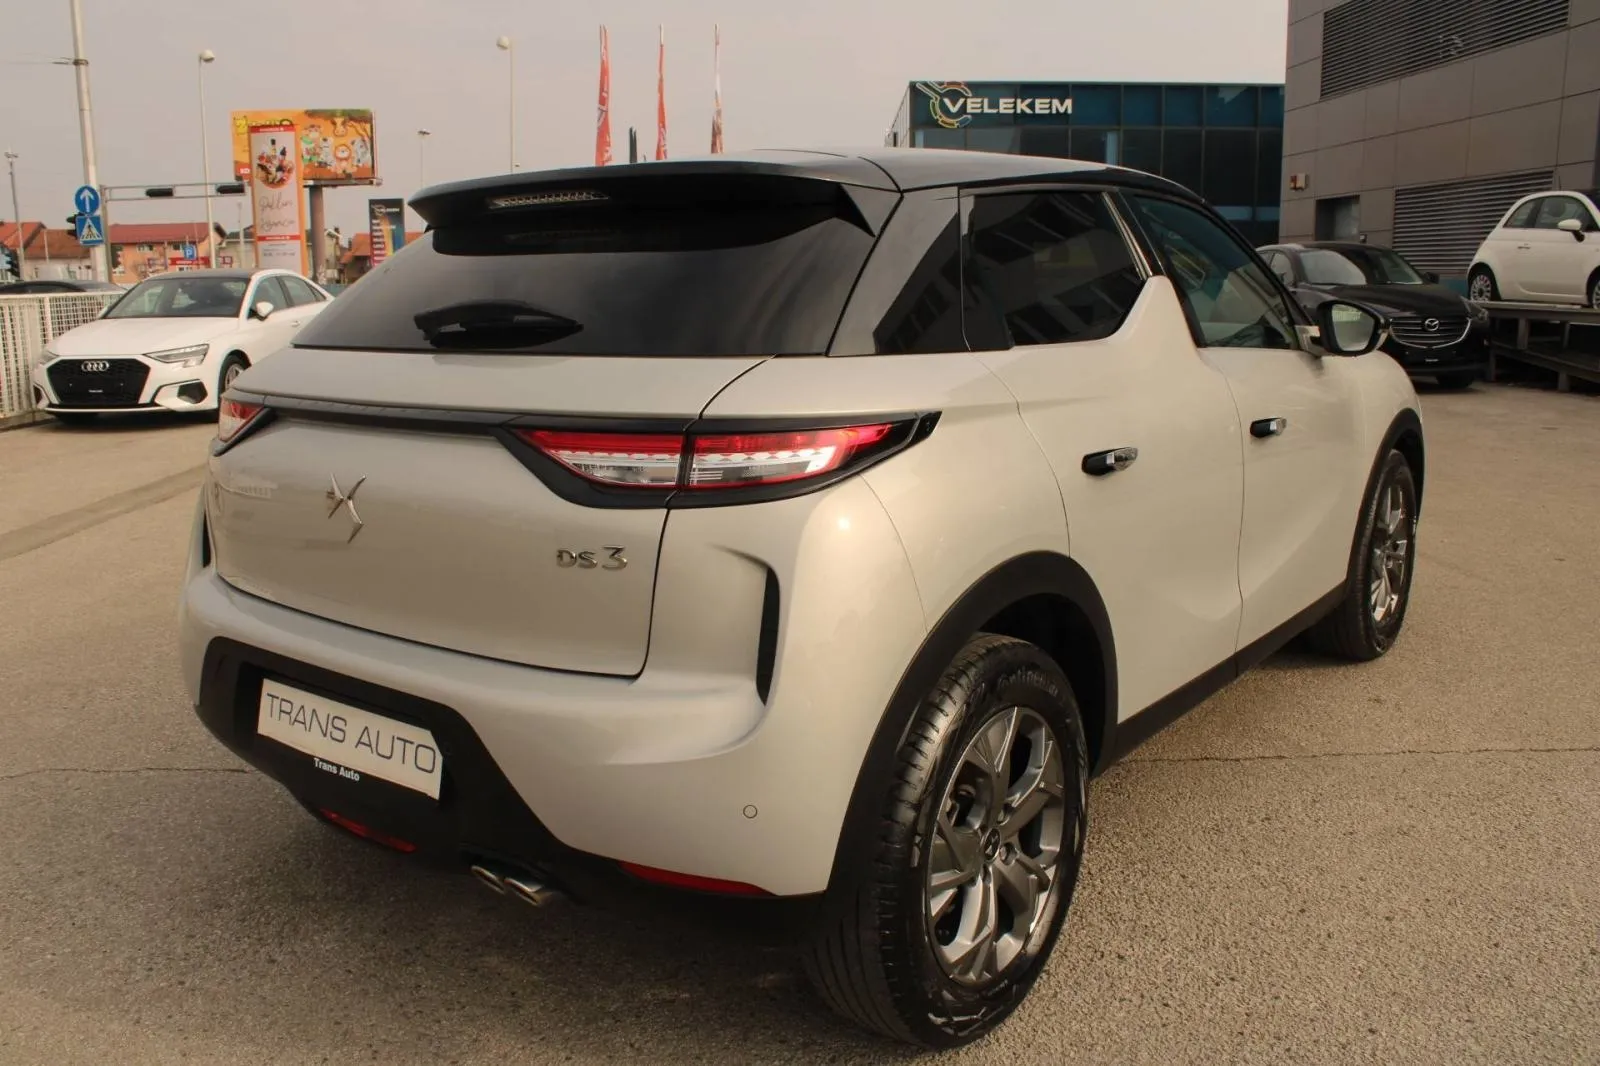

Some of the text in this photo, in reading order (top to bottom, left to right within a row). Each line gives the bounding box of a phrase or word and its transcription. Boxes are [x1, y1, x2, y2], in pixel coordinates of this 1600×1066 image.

[943, 98, 1073, 114] VELEKEM
[266, 692, 437, 775] TRANS AUTO
[313, 757, 361, 782] Trans Auto
